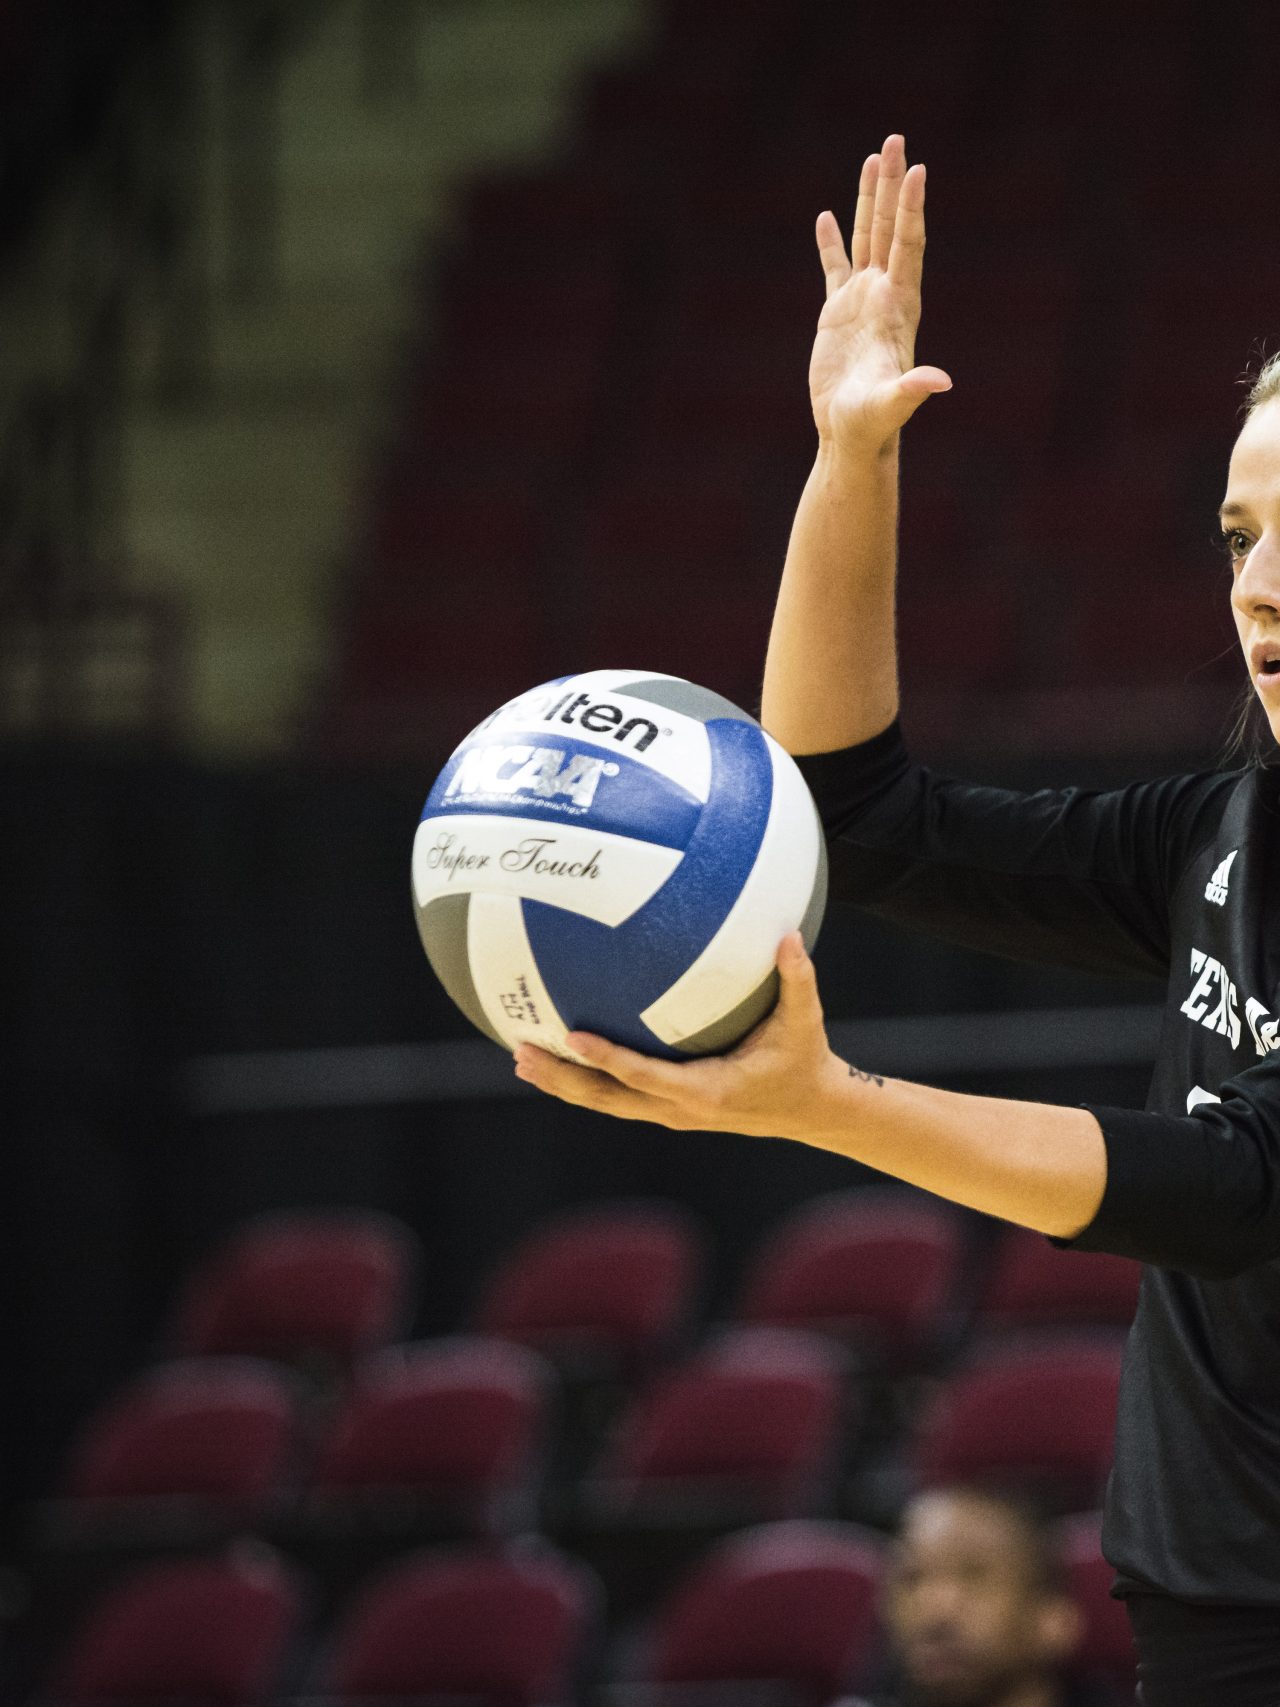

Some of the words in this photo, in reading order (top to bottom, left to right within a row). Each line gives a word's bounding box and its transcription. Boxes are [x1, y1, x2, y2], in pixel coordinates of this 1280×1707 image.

[472, 692, 659, 753] lten
[445, 745, 605, 807] NCAA
[427, 832, 490, 881] Super
[500, 838, 602, 879] Touch
